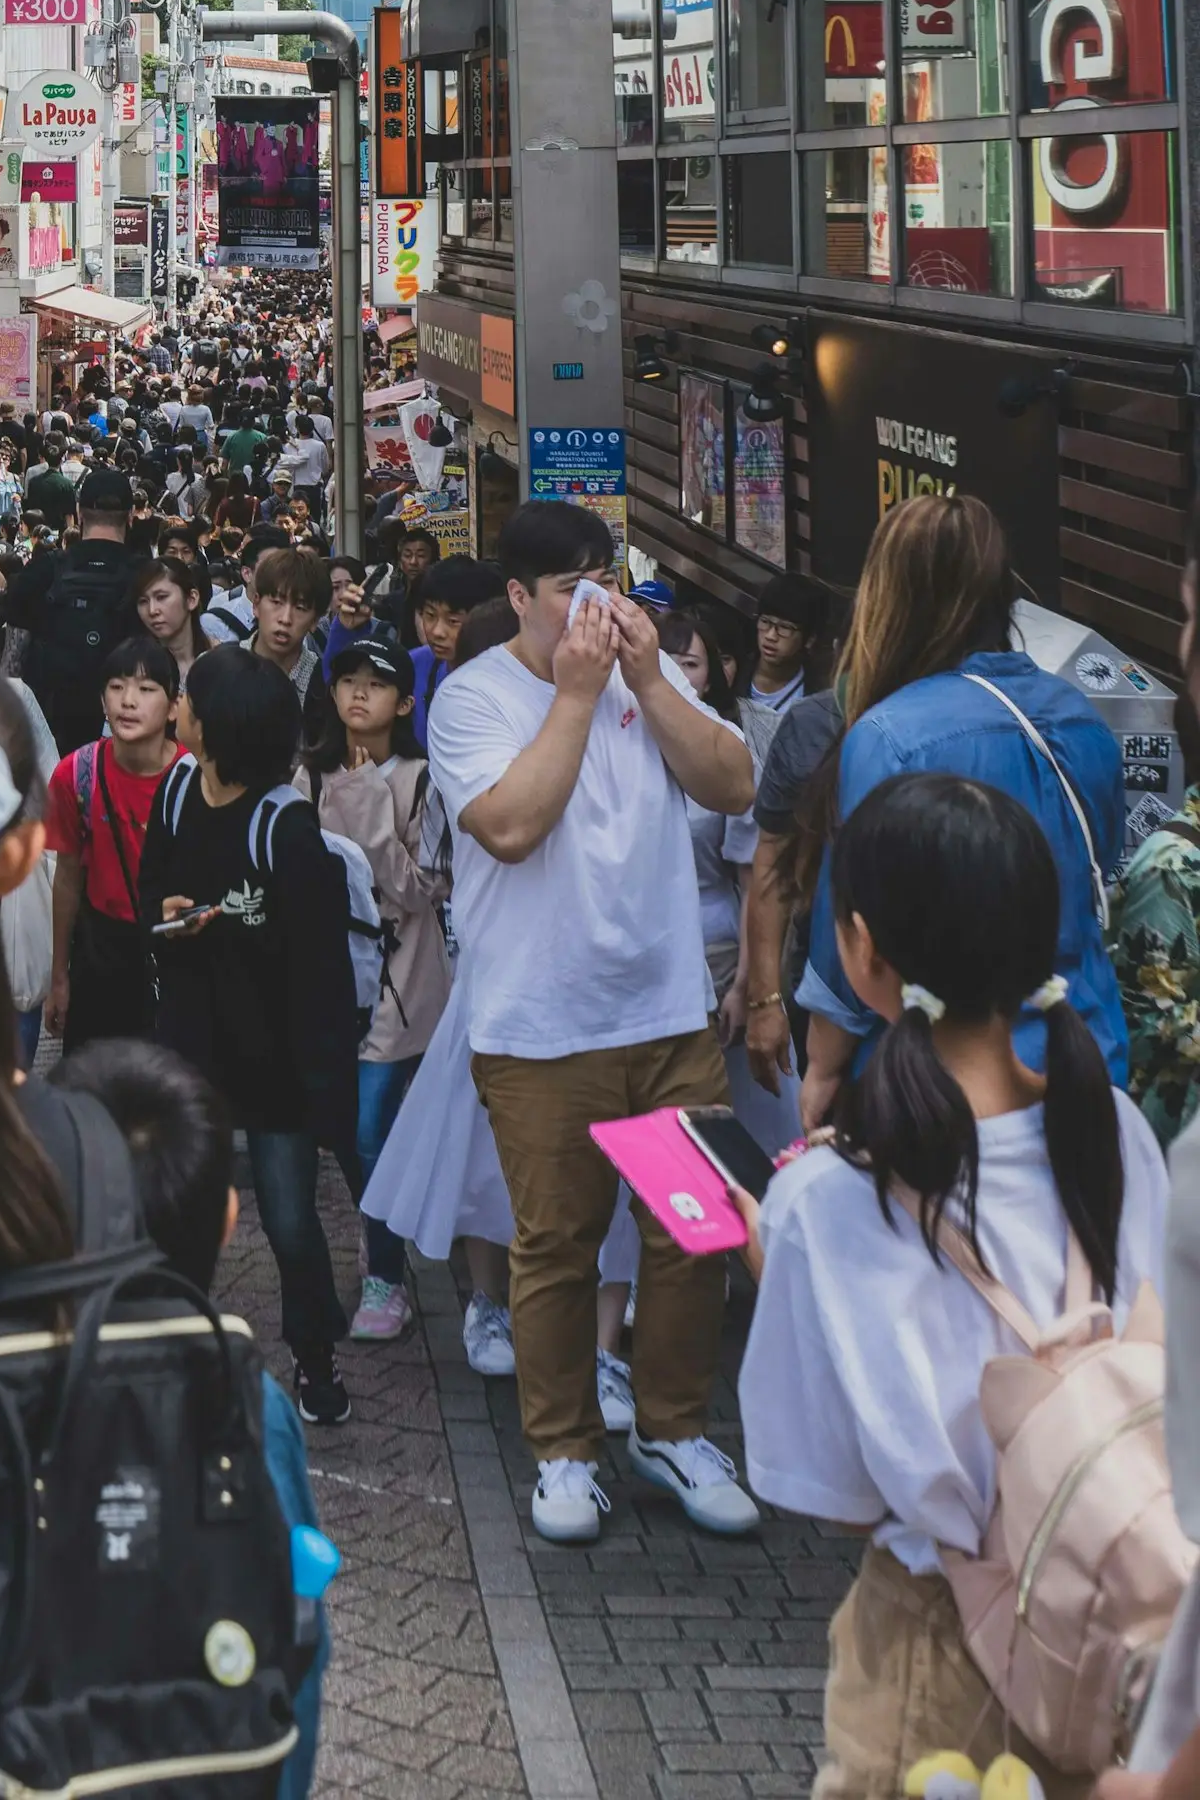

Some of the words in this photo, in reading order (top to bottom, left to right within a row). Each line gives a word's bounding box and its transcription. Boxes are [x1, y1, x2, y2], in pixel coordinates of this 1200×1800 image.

[23, 103, 42, 126] La
[46, 103, 97, 128] Pausa
[383, 66, 403, 139] 吉野家
[407, 68, 416, 137] YOSHINOYA
[226, 208, 277, 227] SHINING
[280, 209, 312, 228] STAR
[377, 203, 389, 275] PURIKURA
[394, 200, 423, 302] プリクラ
[483, 346, 513, 383] EXPRESS
[876, 416, 957, 467] WOLFGANG
[429, 518, 464, 528] MONEY
